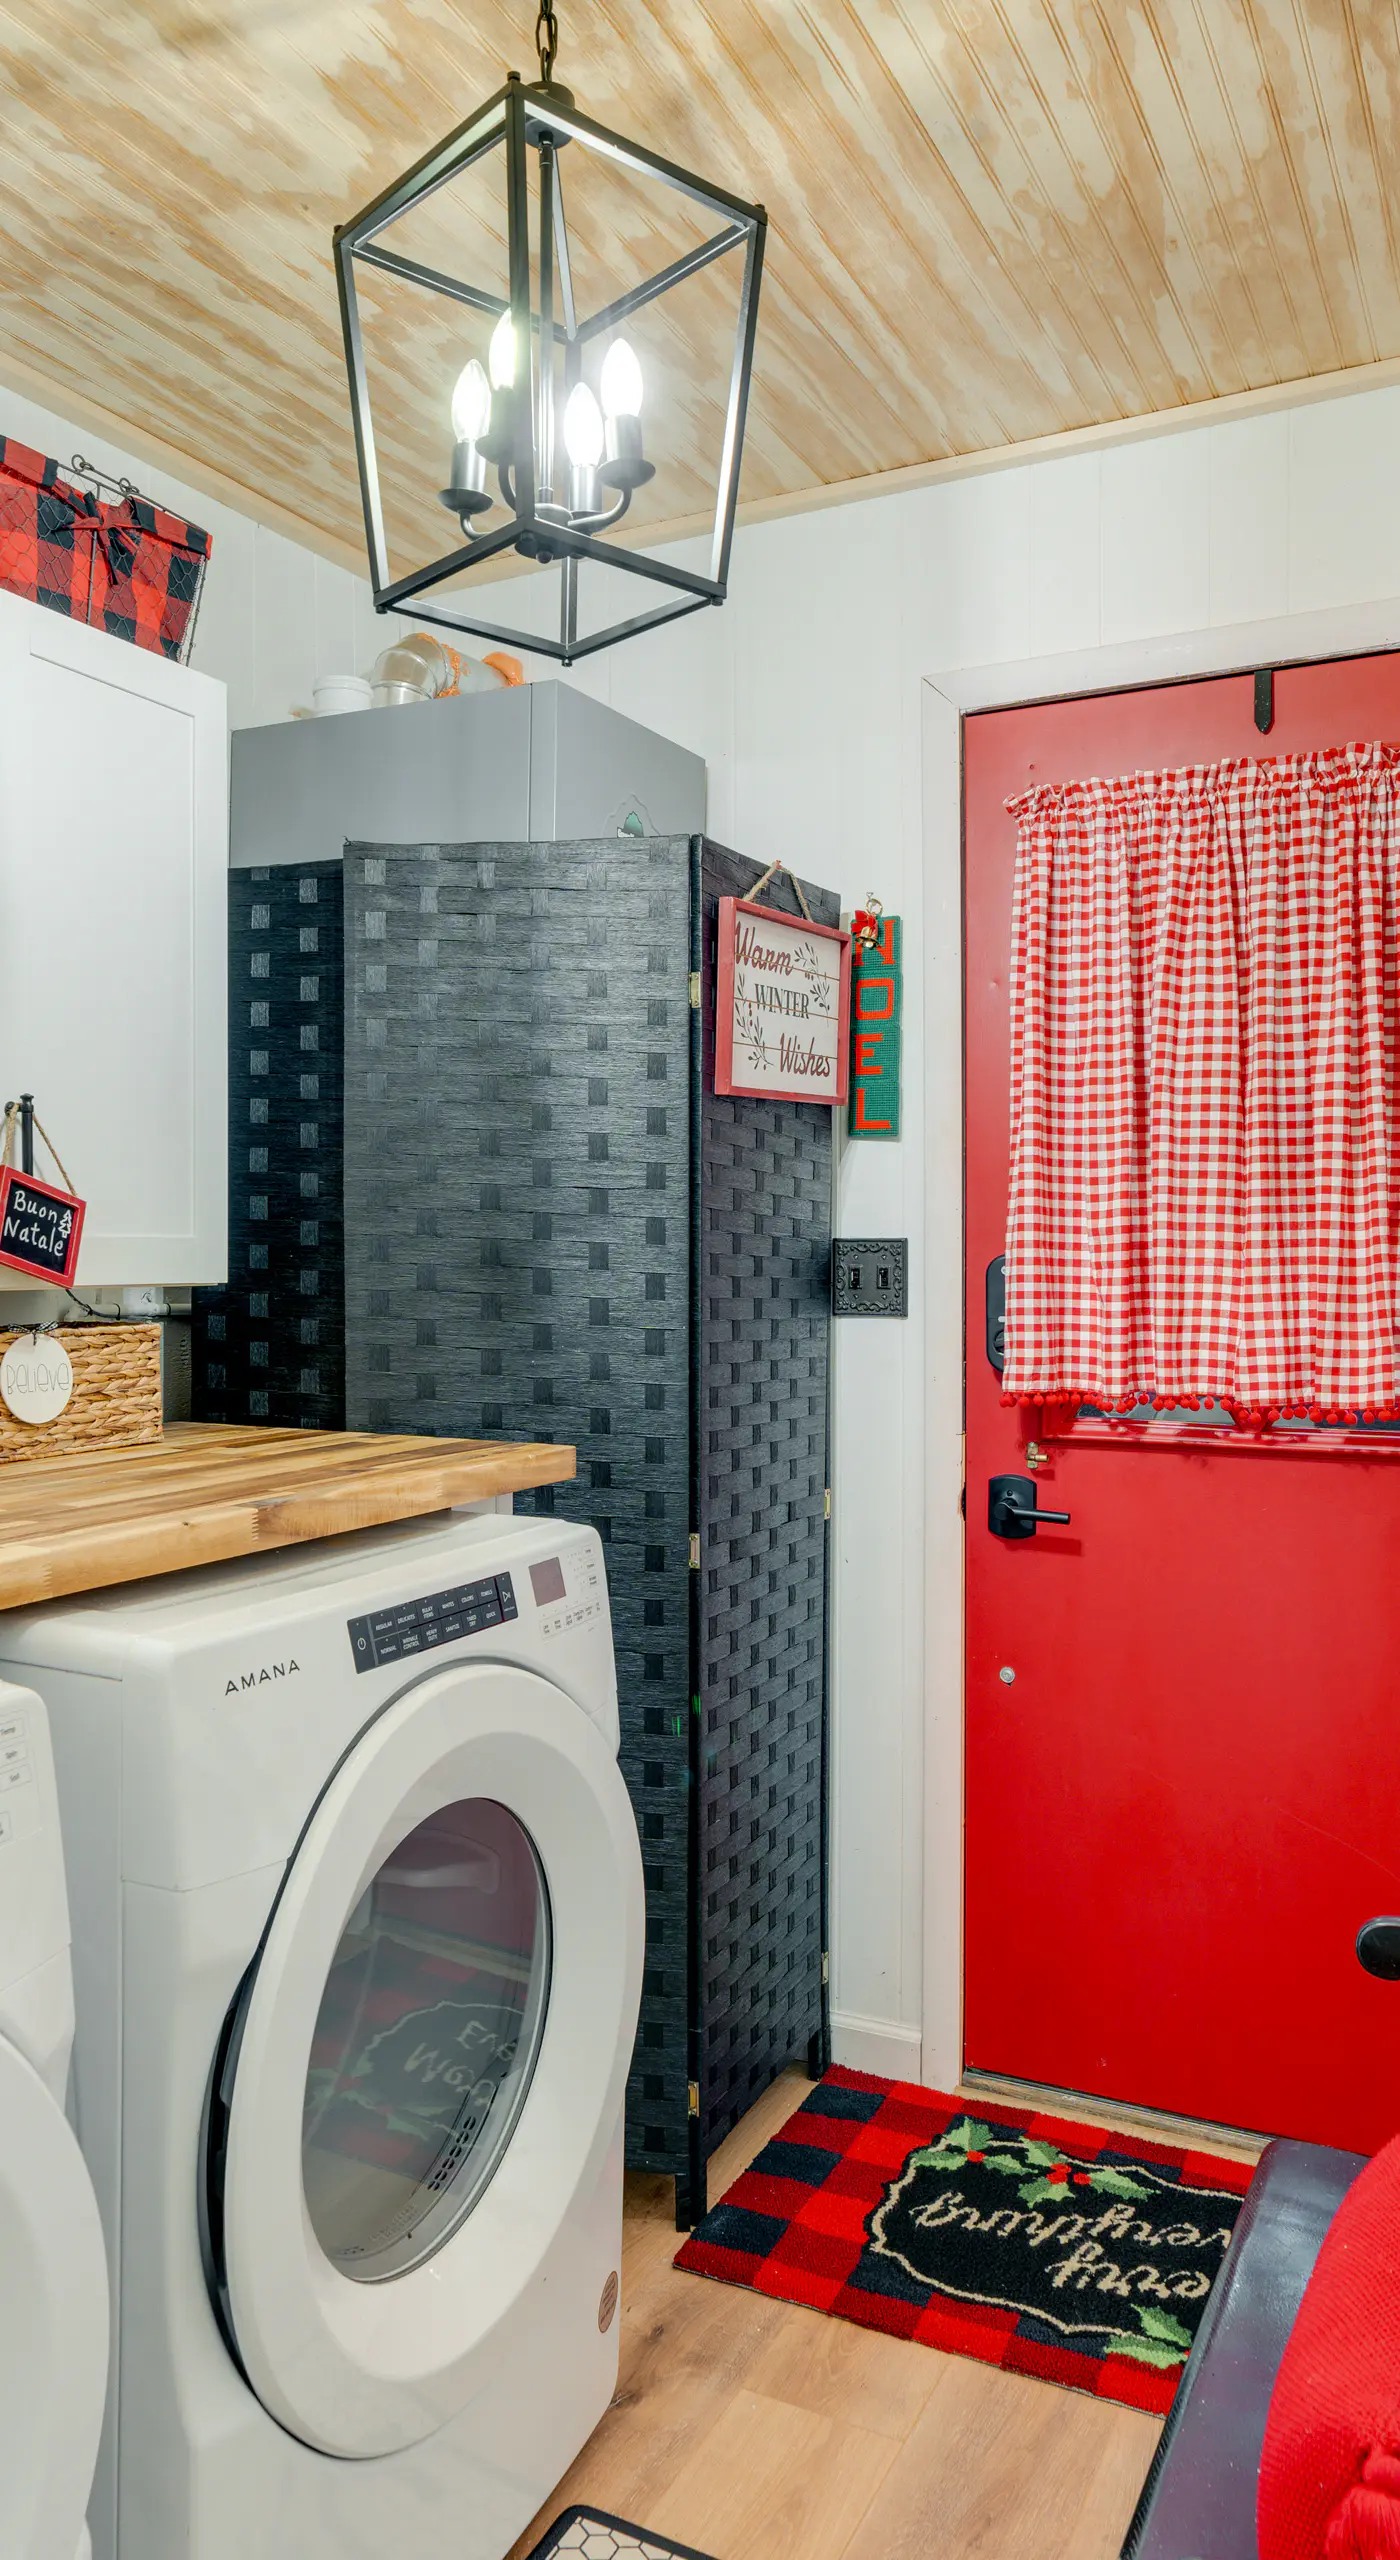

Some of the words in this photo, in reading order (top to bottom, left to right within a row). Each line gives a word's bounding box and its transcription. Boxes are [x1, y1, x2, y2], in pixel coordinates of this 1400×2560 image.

[735, 920, 793, 976] Warm
[754, 983, 810, 1019] WINTER
[853, 919, 896, 1130] NOEL
[779, 1032, 830, 1078] Wishes
[13, 1190, 58, 1224] Buon
[3, 1216, 64, 1257] Natale
[225, 1660, 300, 1696] AMANA
[909, 2192, 1233, 2249] verything
[1045, 2241, 1211, 2298] erry
